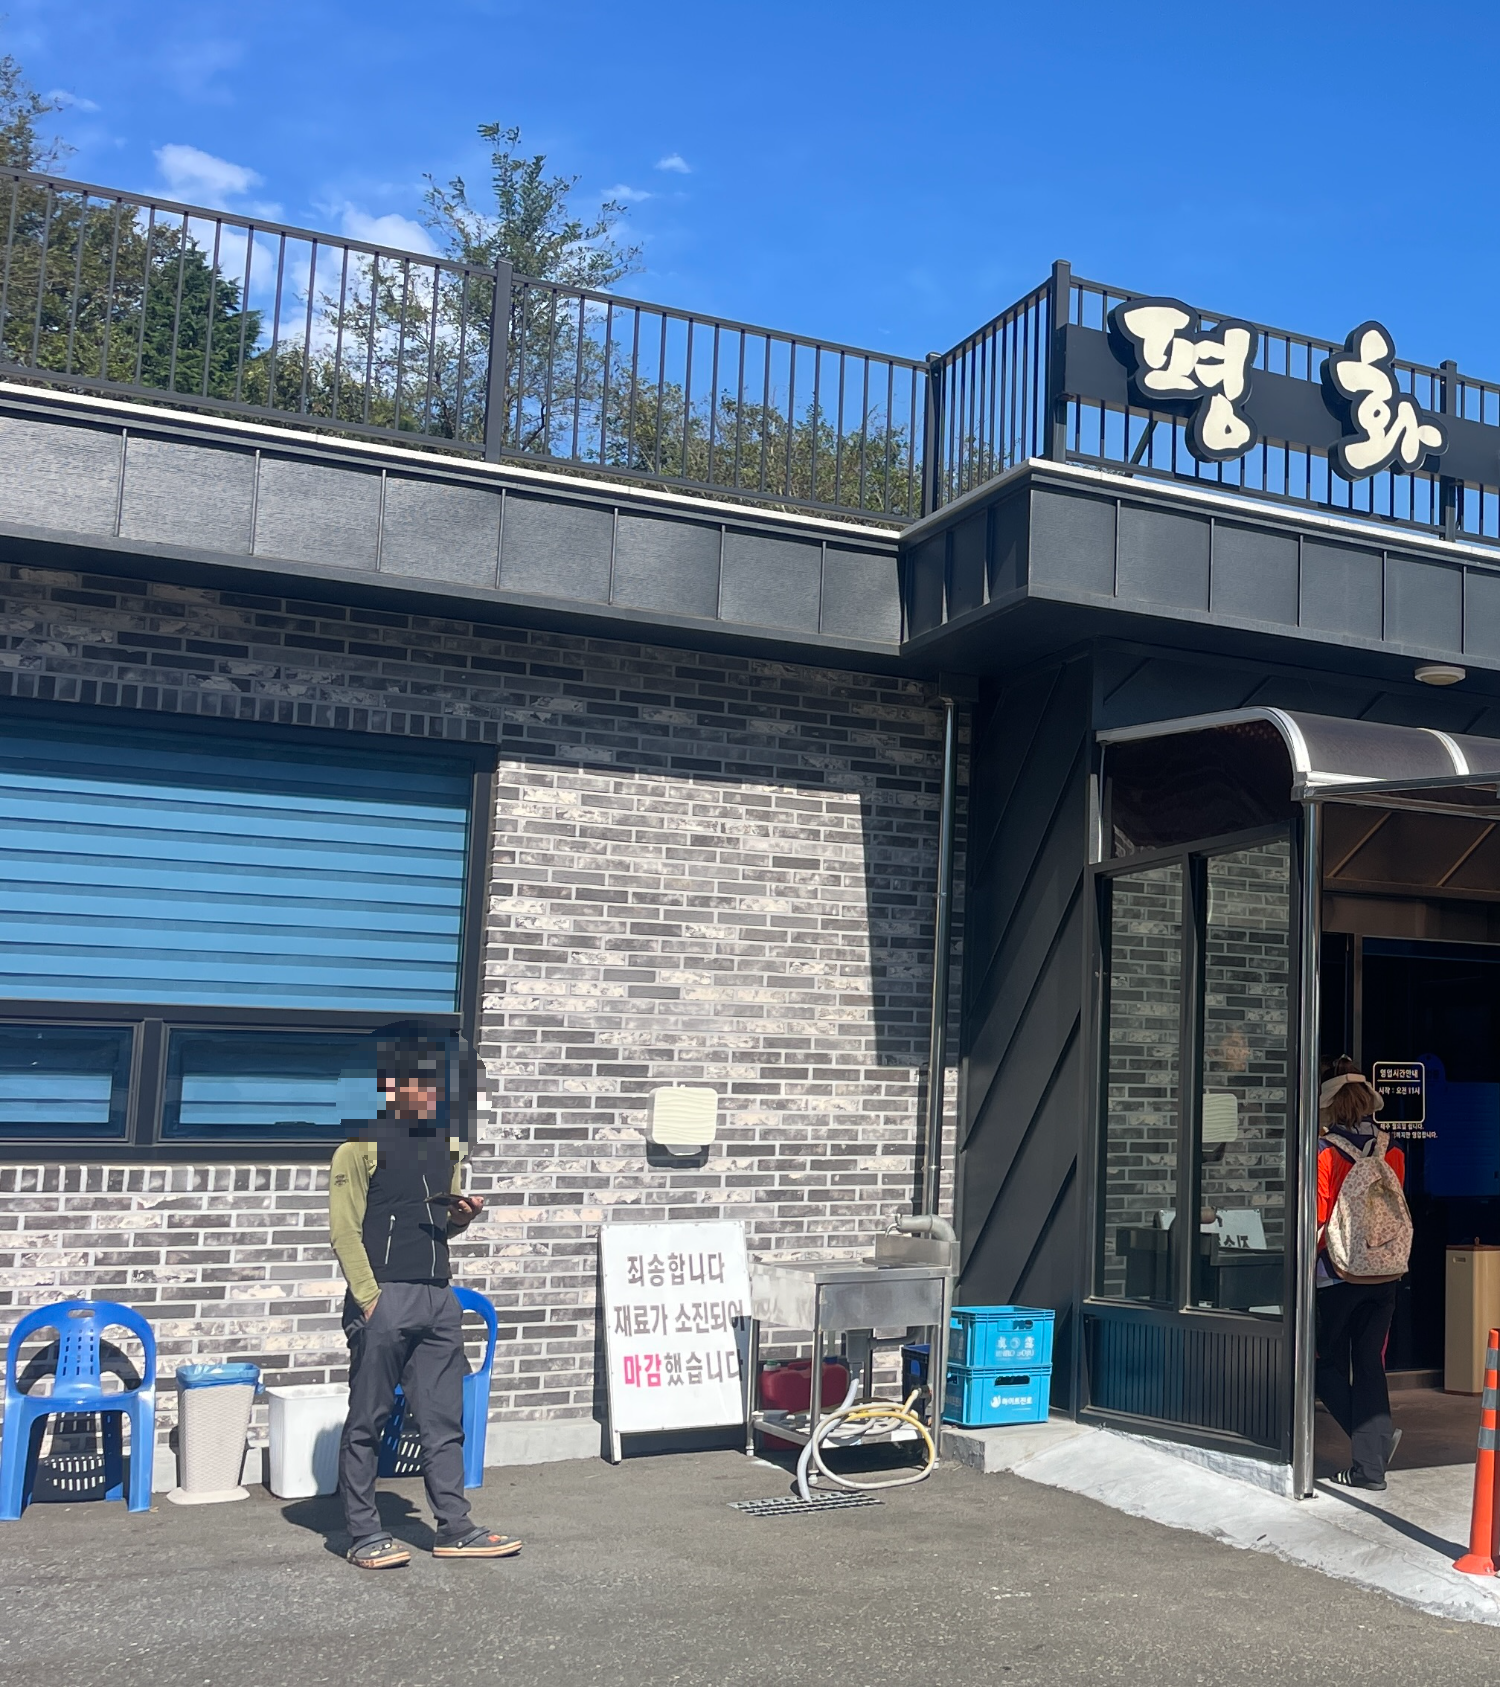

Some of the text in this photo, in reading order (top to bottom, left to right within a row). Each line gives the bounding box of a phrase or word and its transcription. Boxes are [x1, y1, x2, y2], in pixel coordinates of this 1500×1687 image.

[1380, 1069, 1418, 1078] 영업시간안내
[1396, 1087, 1407, 1095] 오전
[627, 1252, 725, 1287] 죄송합니다
[614, 1299, 745, 1337] 재료가 소진되어
[624, 1349, 743, 1388] 마감했습니다
